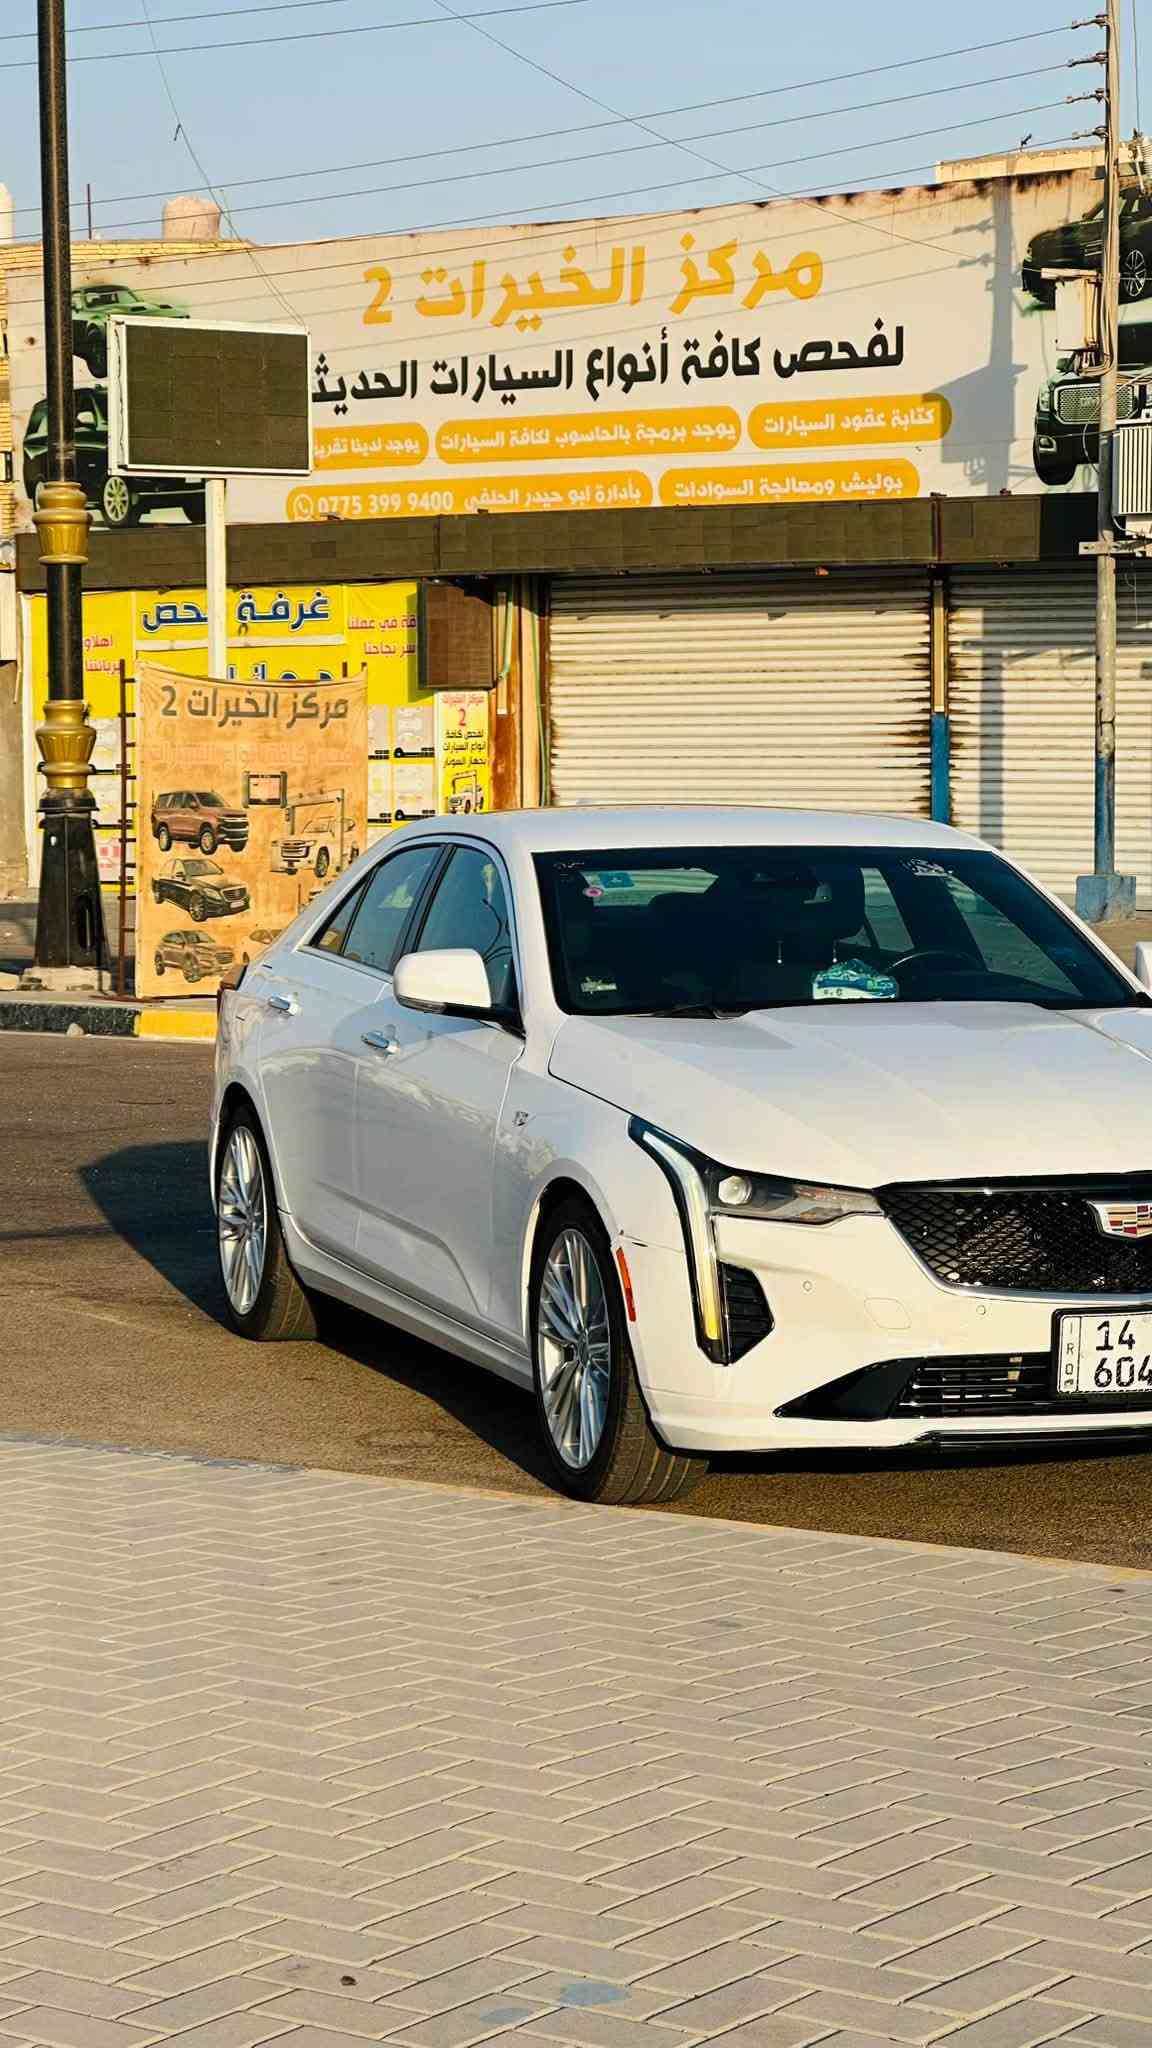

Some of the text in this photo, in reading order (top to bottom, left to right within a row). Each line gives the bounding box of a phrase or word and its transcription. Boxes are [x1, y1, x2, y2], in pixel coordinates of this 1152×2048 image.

[362, 232, 823, 332] مركز الخيرات 2
[312, 317, 904, 415] لفحص كافة أنواع السيارات الحديث
[764, 406, 935, 437] كتابة عقود السيارات
[351, 436, 382, 457] لدينا
[385, 437, 420, 456] يوجد
[440, 421, 736, 454] يوجد برمجة بالحاسوب لكافة السيارات
[525, 487, 563, 508] حيدر
[674, 471, 903, 500] بوليش ومعالجة السوادات
[318, 495, 362, 514] 0775
[369, 493, 401, 513] 399
[407, 490, 453, 512] 9400
[142, 590, 330, 632] غرفة حص
[160, 685, 349, 729] مركز الخيرات 2
[457, 707, 467, 726] 2
[1096, 1319, 1136, 1351] 14
[1094, 1354, 1152, 1388] 604
